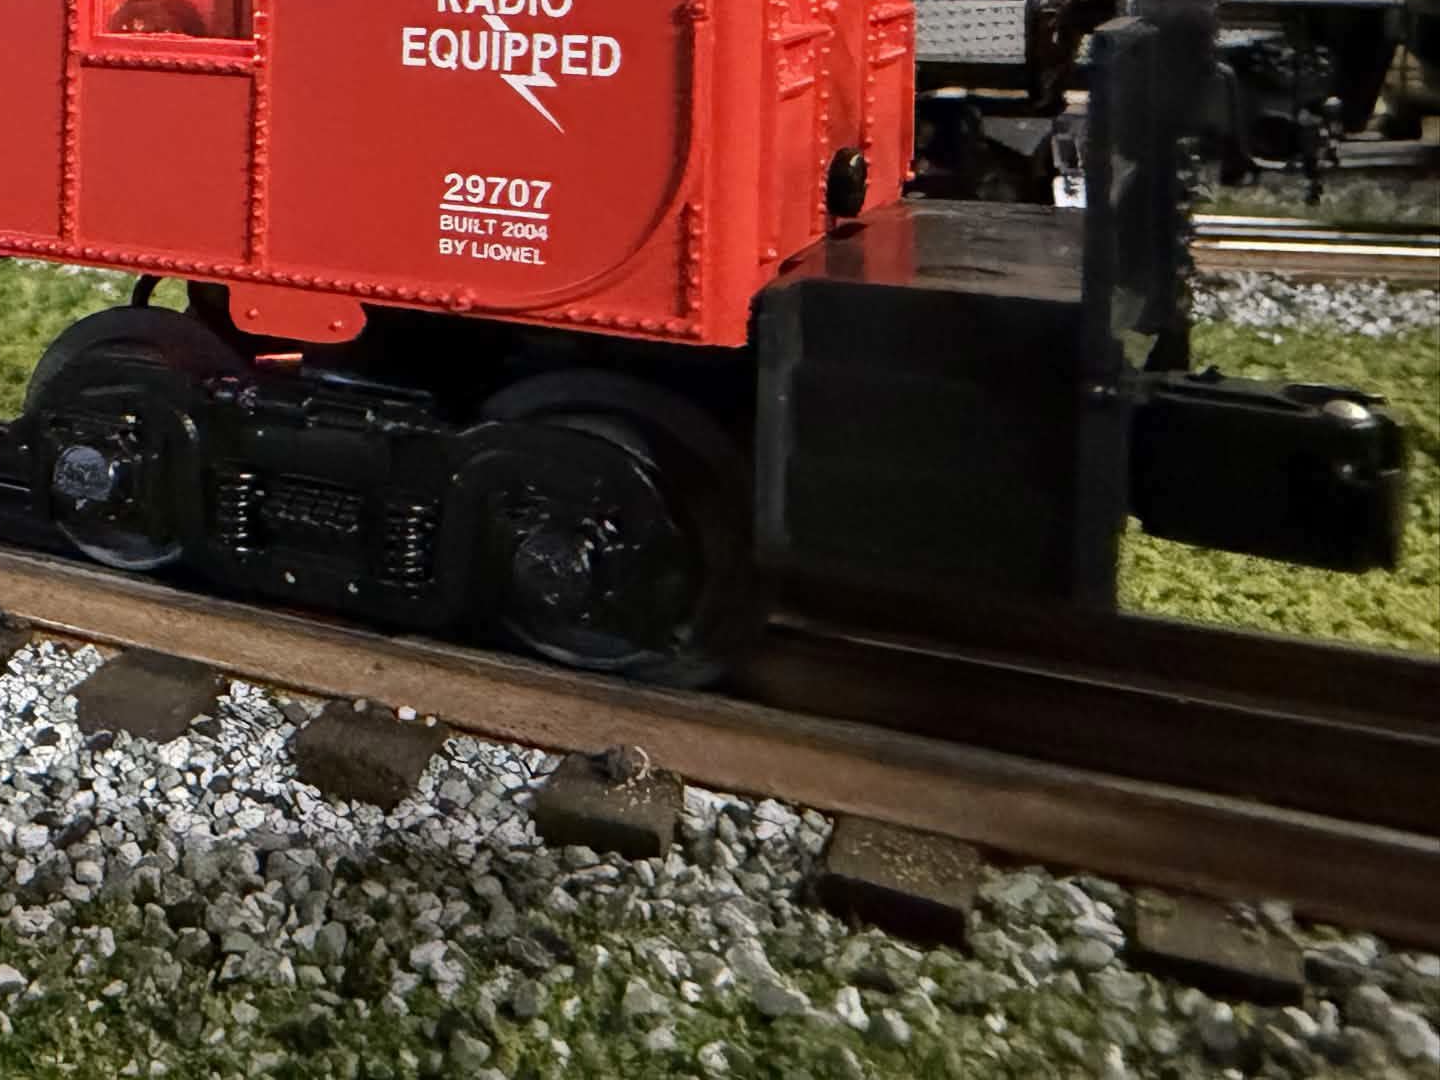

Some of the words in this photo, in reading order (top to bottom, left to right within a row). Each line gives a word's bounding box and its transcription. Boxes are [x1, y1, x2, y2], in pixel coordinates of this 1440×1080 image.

[401, 27, 622, 77] EQUIPPED
[442, 172, 552, 209] 29707
[439, 215, 497, 235] BUILT
[501, 222, 549, 241] 2004
[439, 238, 469, 255] BY
[471, 241, 547, 265] LIONEL
